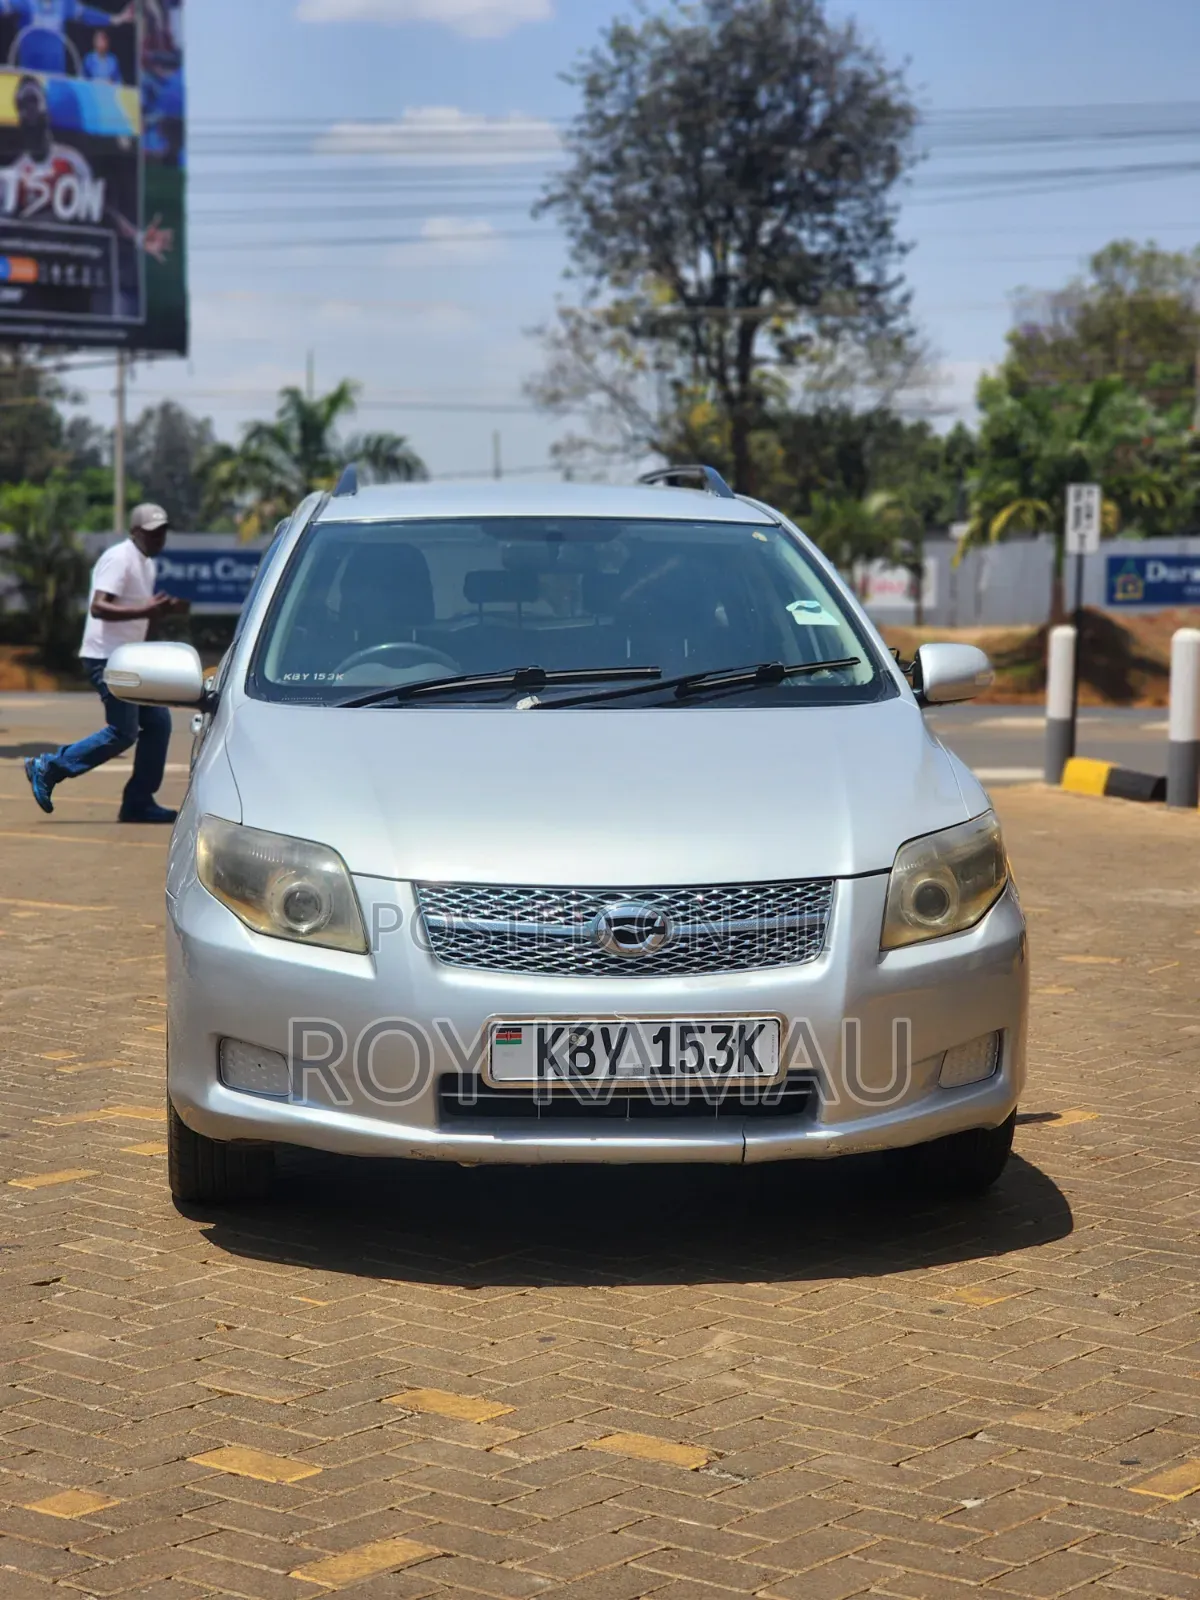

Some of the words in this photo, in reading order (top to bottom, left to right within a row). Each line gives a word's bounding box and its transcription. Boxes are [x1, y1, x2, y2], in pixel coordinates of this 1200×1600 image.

[283, 673, 310, 681] KBY
[313, 673, 345, 681] 153K
[536, 1026, 628, 1077] KBY
[652, 1023, 766, 1075] 153K
